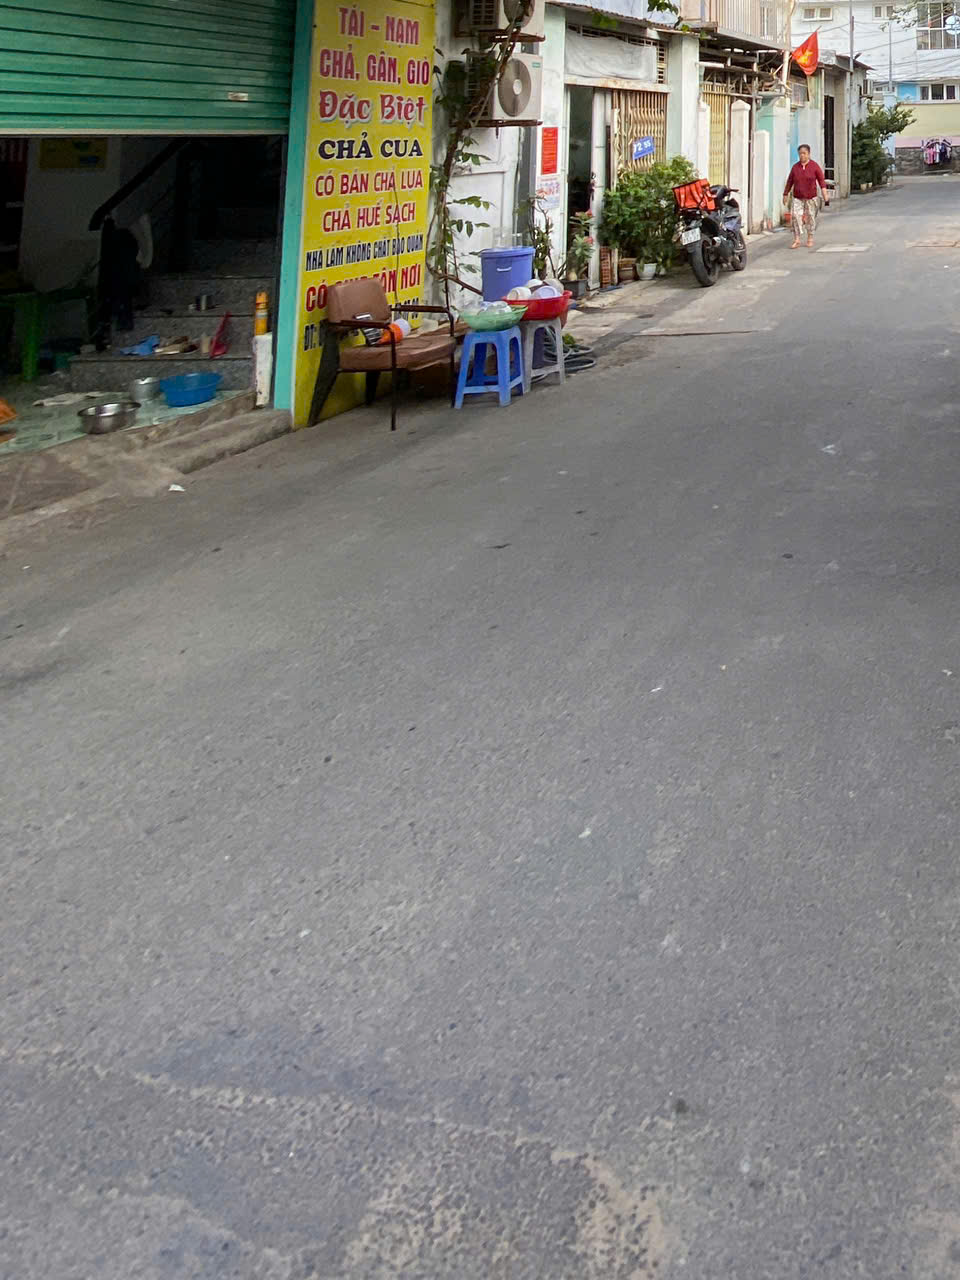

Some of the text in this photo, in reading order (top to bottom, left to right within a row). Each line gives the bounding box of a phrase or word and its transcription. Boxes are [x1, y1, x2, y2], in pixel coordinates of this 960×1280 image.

[339, 4, 365, 37] TÁI
[385, 15, 420, 48] NẠM
[319, 43, 430, 85] CHẢ, GÂN, GIÒ
[319, 90, 425, 125] Đặc Biệt
[318, 131, 423, 159] CHẢ CUA
[315, 169, 335, 196] CÓ
[340, 168, 369, 195] BÁN
[373, 166, 395, 192] CHẢ
[322, 199, 416, 232] CHẢ HUẾ SẠCH
[345, 240, 371, 264] KHÔNG
[373, 236, 391, 260] CHẤT
[305, 280, 328, 312] CÓ
[400, 263, 421, 290] NƠI
